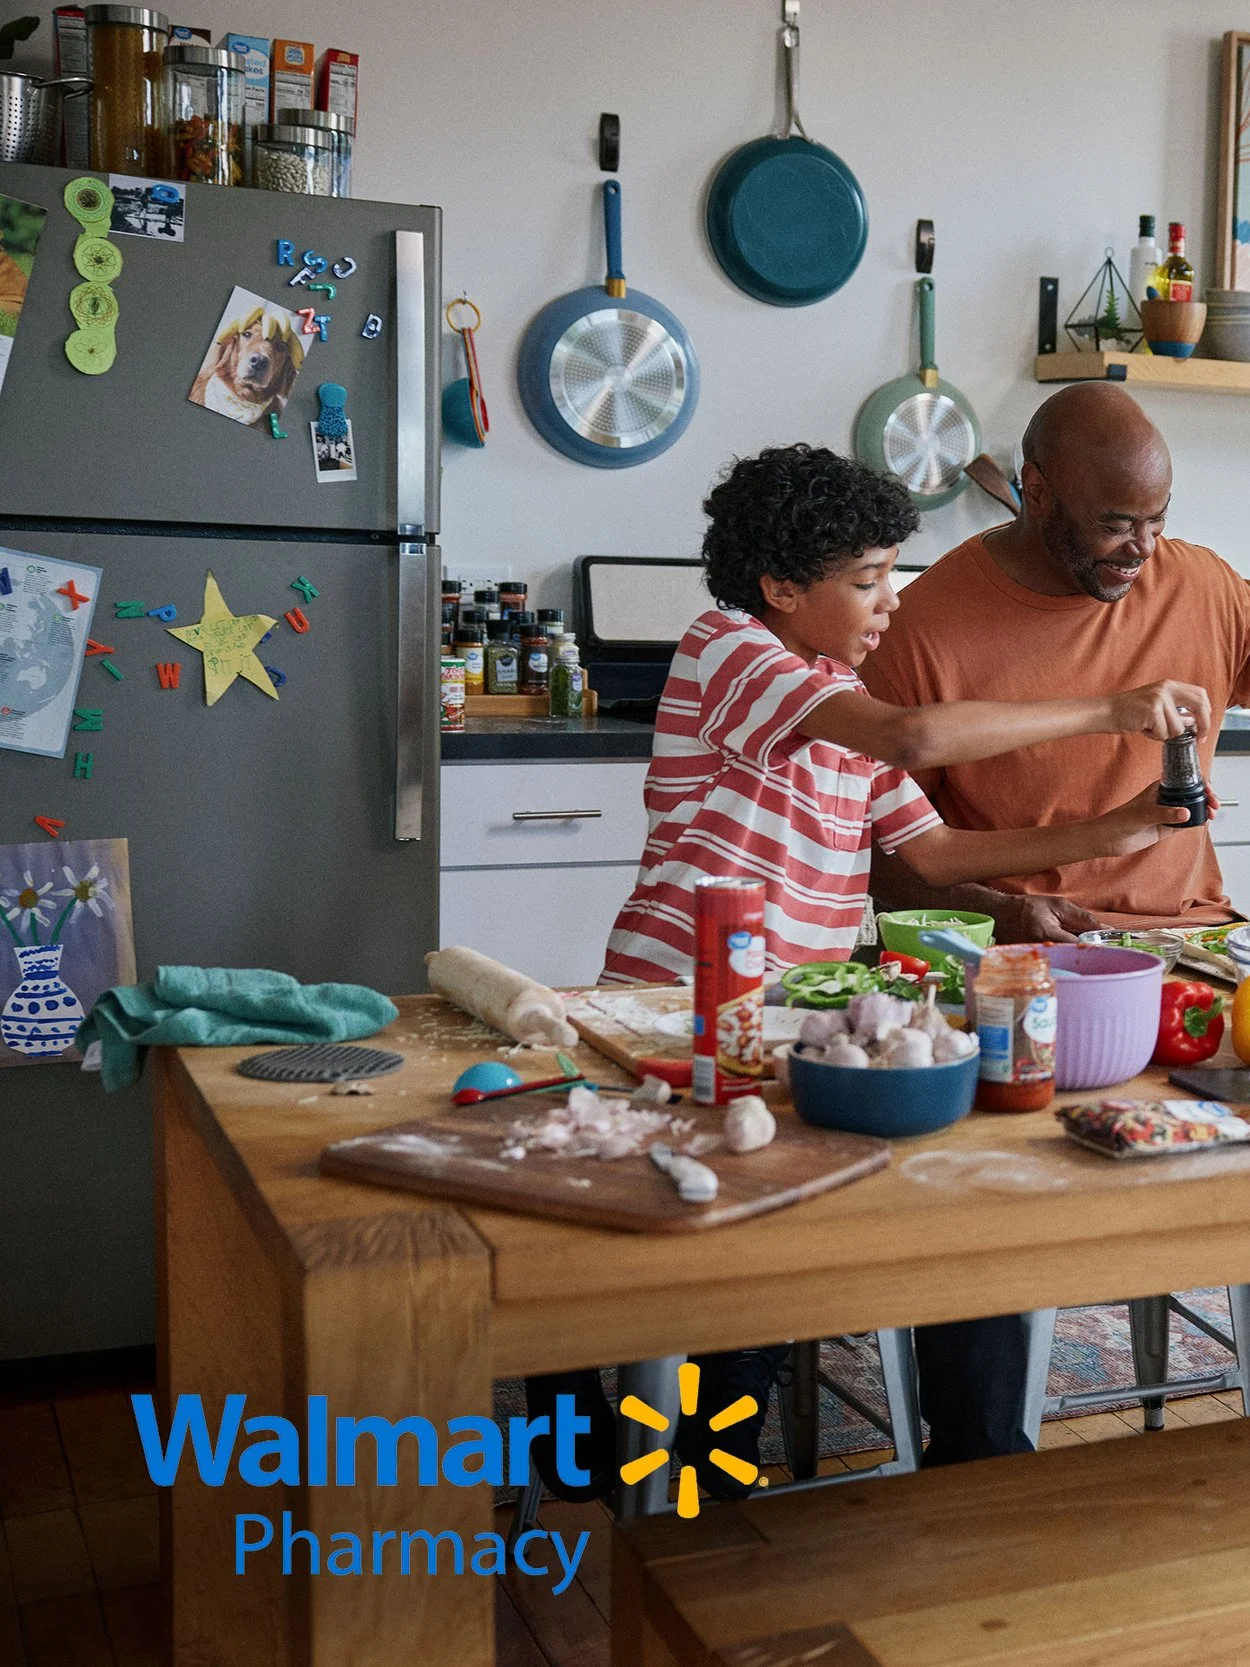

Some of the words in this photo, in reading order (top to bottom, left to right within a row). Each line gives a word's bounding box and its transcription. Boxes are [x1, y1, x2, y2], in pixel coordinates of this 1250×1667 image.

[277, 239, 296, 266] R
[56, 579, 90, 611] X
[156, 662, 181, 689] W
[73, 751, 94, 780] H
